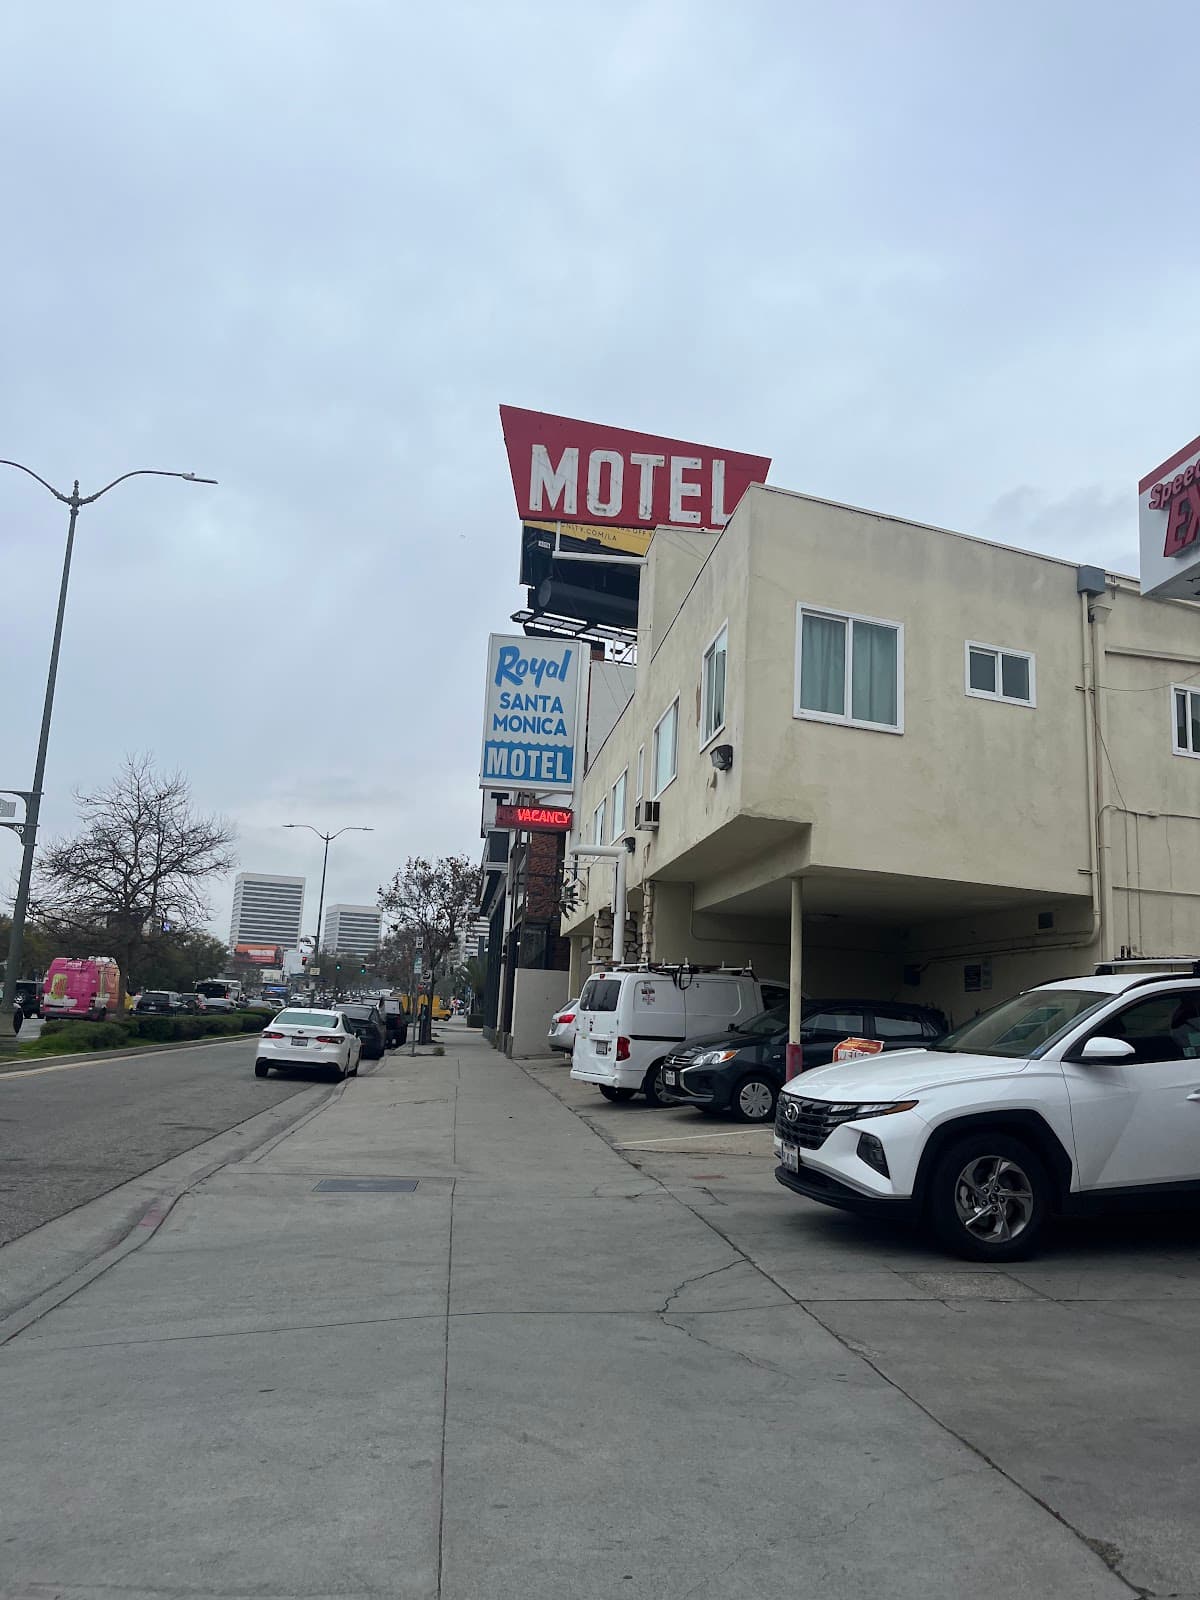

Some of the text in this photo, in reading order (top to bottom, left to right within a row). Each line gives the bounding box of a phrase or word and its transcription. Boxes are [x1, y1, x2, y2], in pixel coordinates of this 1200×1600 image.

[528, 444, 733, 525] MOTEL
[494, 645, 573, 688] Royal
[499, 691, 564, 714] SANTA
[492, 713, 568, 737] MONICA
[486, 747, 568, 780] MOTEL
[517, 808, 571, 824] VACANCY
